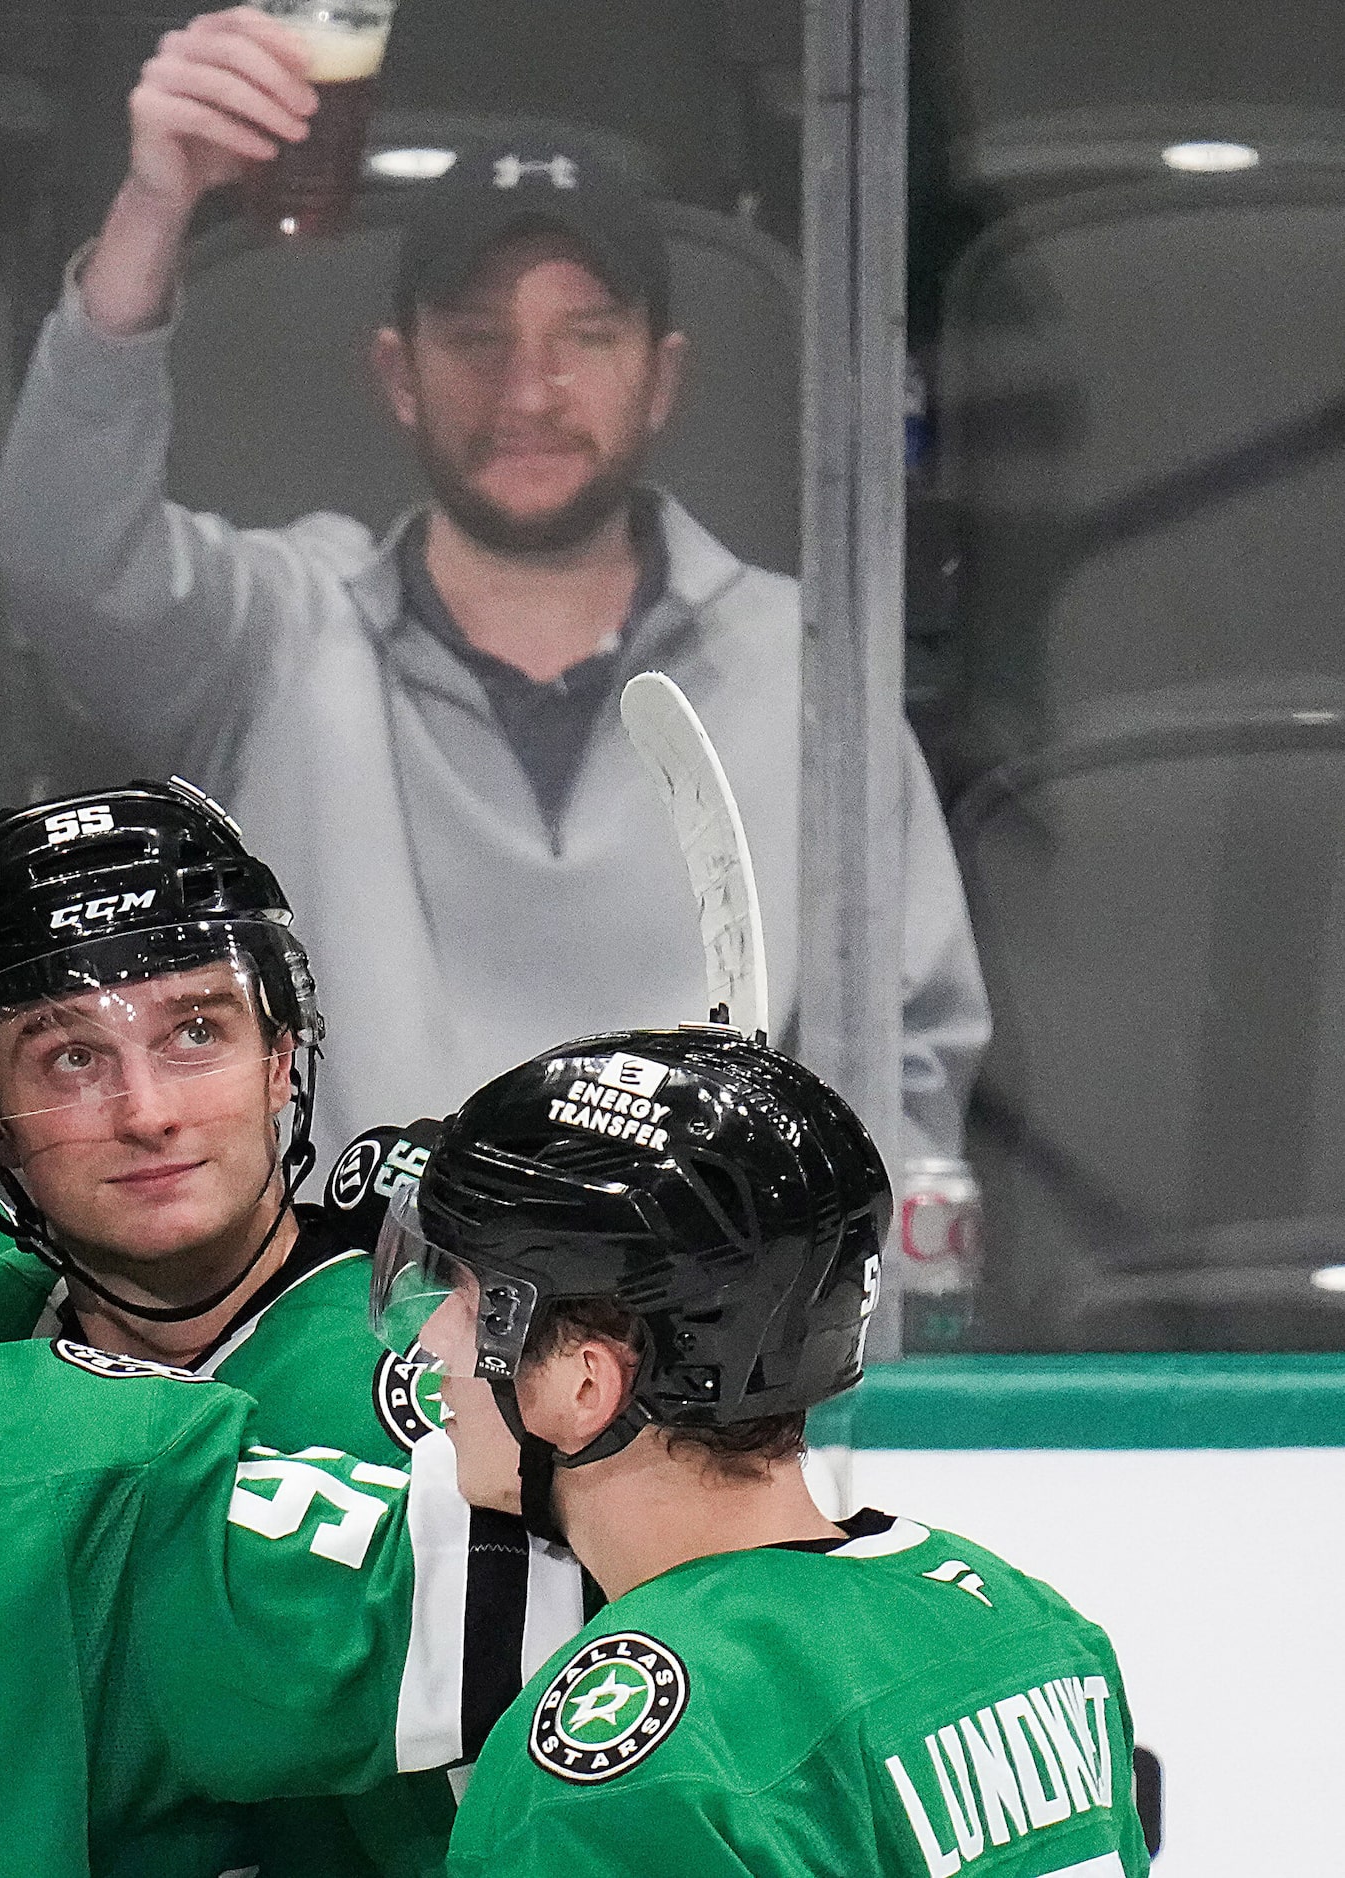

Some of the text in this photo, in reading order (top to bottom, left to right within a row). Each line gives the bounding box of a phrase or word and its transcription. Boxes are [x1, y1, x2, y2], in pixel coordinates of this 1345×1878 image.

[45, 805, 114, 844] 55
[49, 889, 156, 929] CCM
[548, 1099, 669, 1151] TRANSFER
[567, 1080, 671, 1124] ENERGY
[227, 1444, 412, 1569] 9
[544, 1641, 674, 1710] DALLAS
[541, 1717, 661, 1770] STARS
